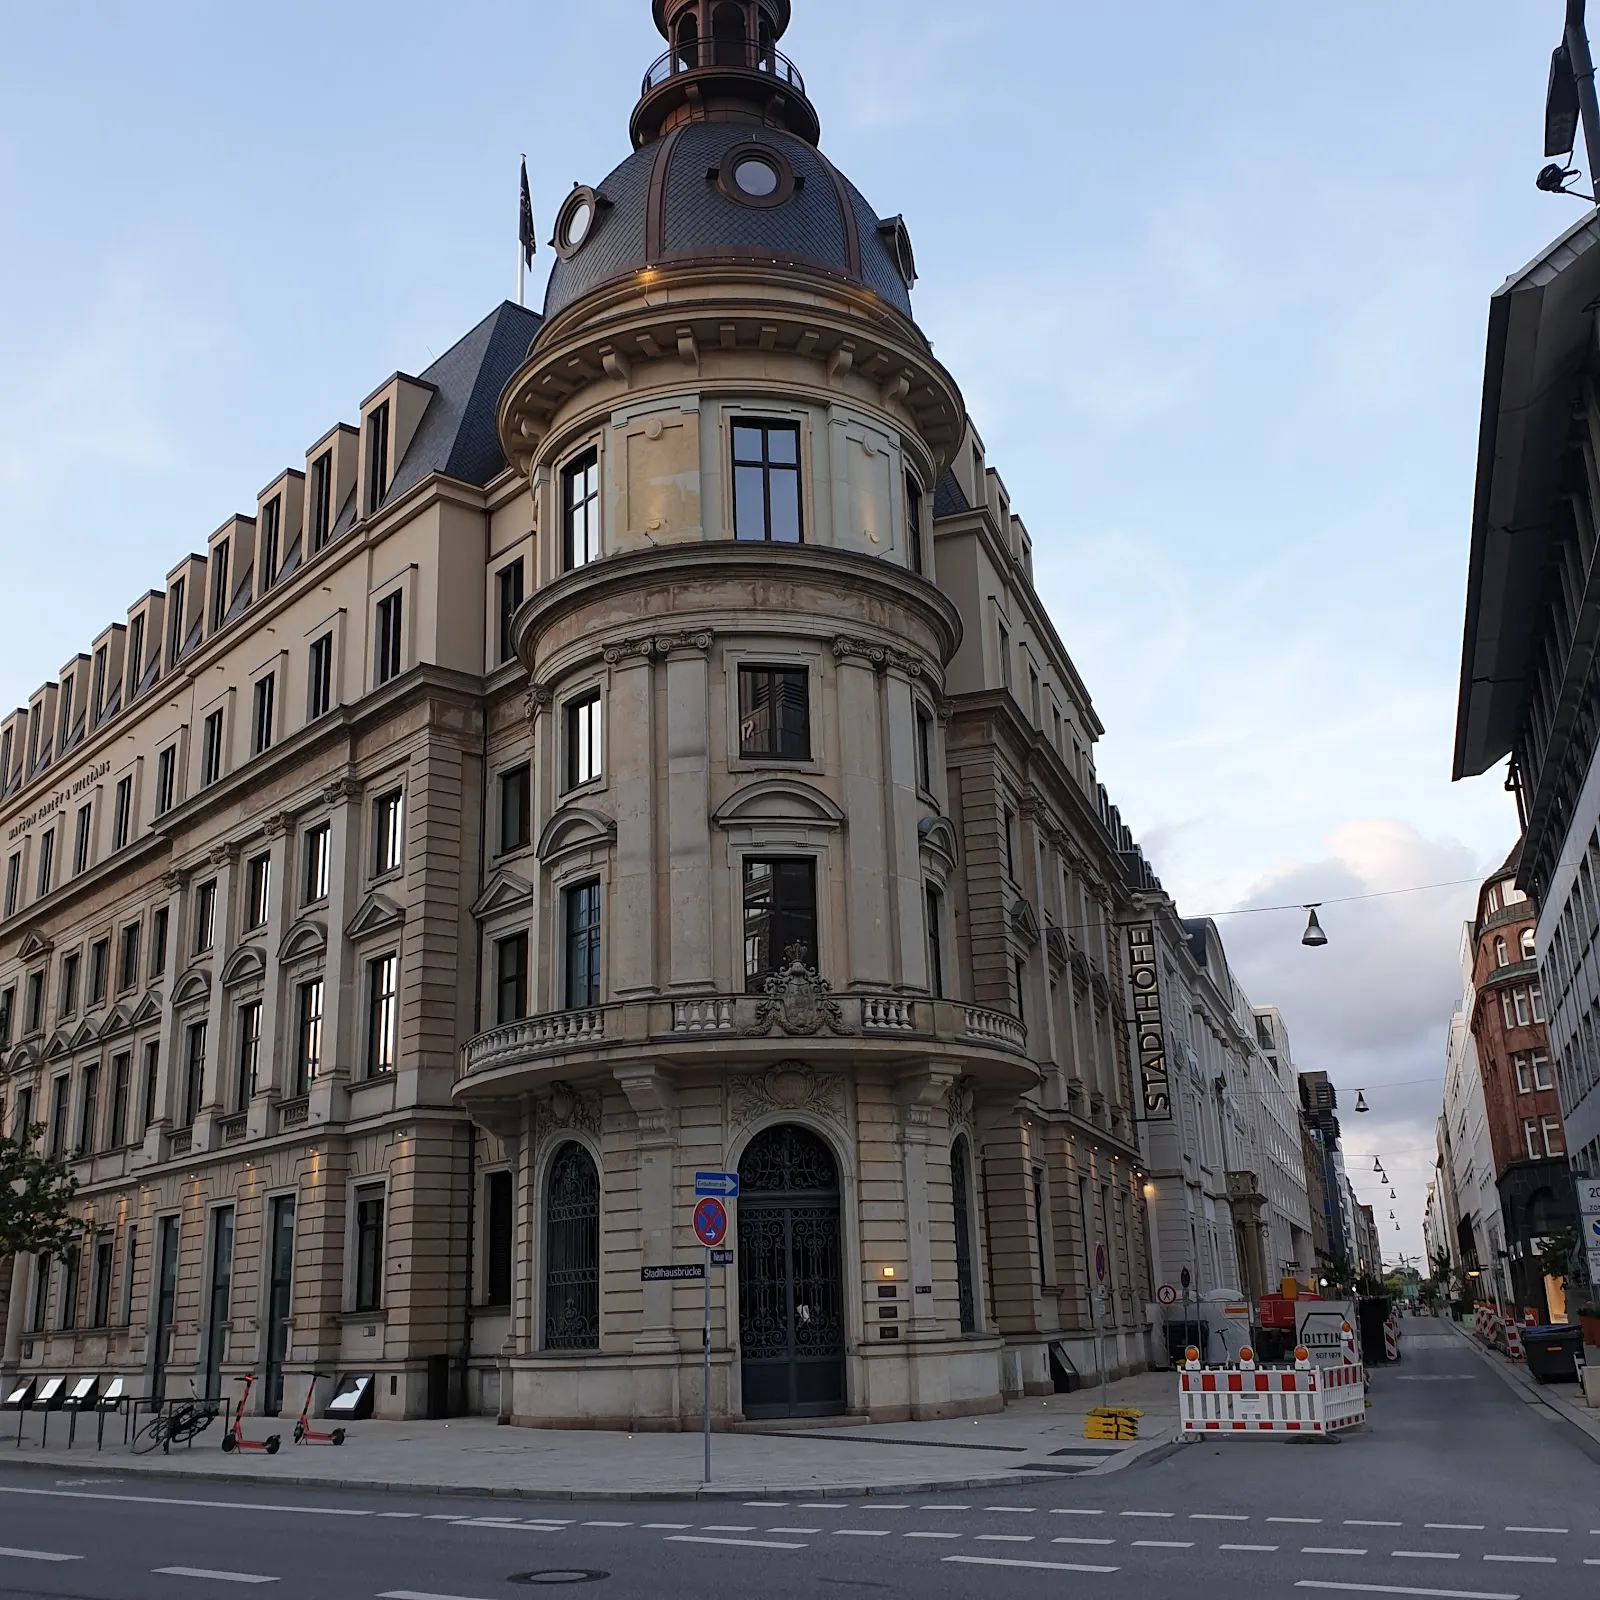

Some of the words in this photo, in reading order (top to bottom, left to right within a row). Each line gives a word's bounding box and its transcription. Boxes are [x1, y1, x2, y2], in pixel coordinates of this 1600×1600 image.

[1128, 927, 1169, 1112] STADTHÖFE
[643, 1267, 702, 1279] Stadthausbrücke
[1315, 1352, 1327, 1360] SEIT
